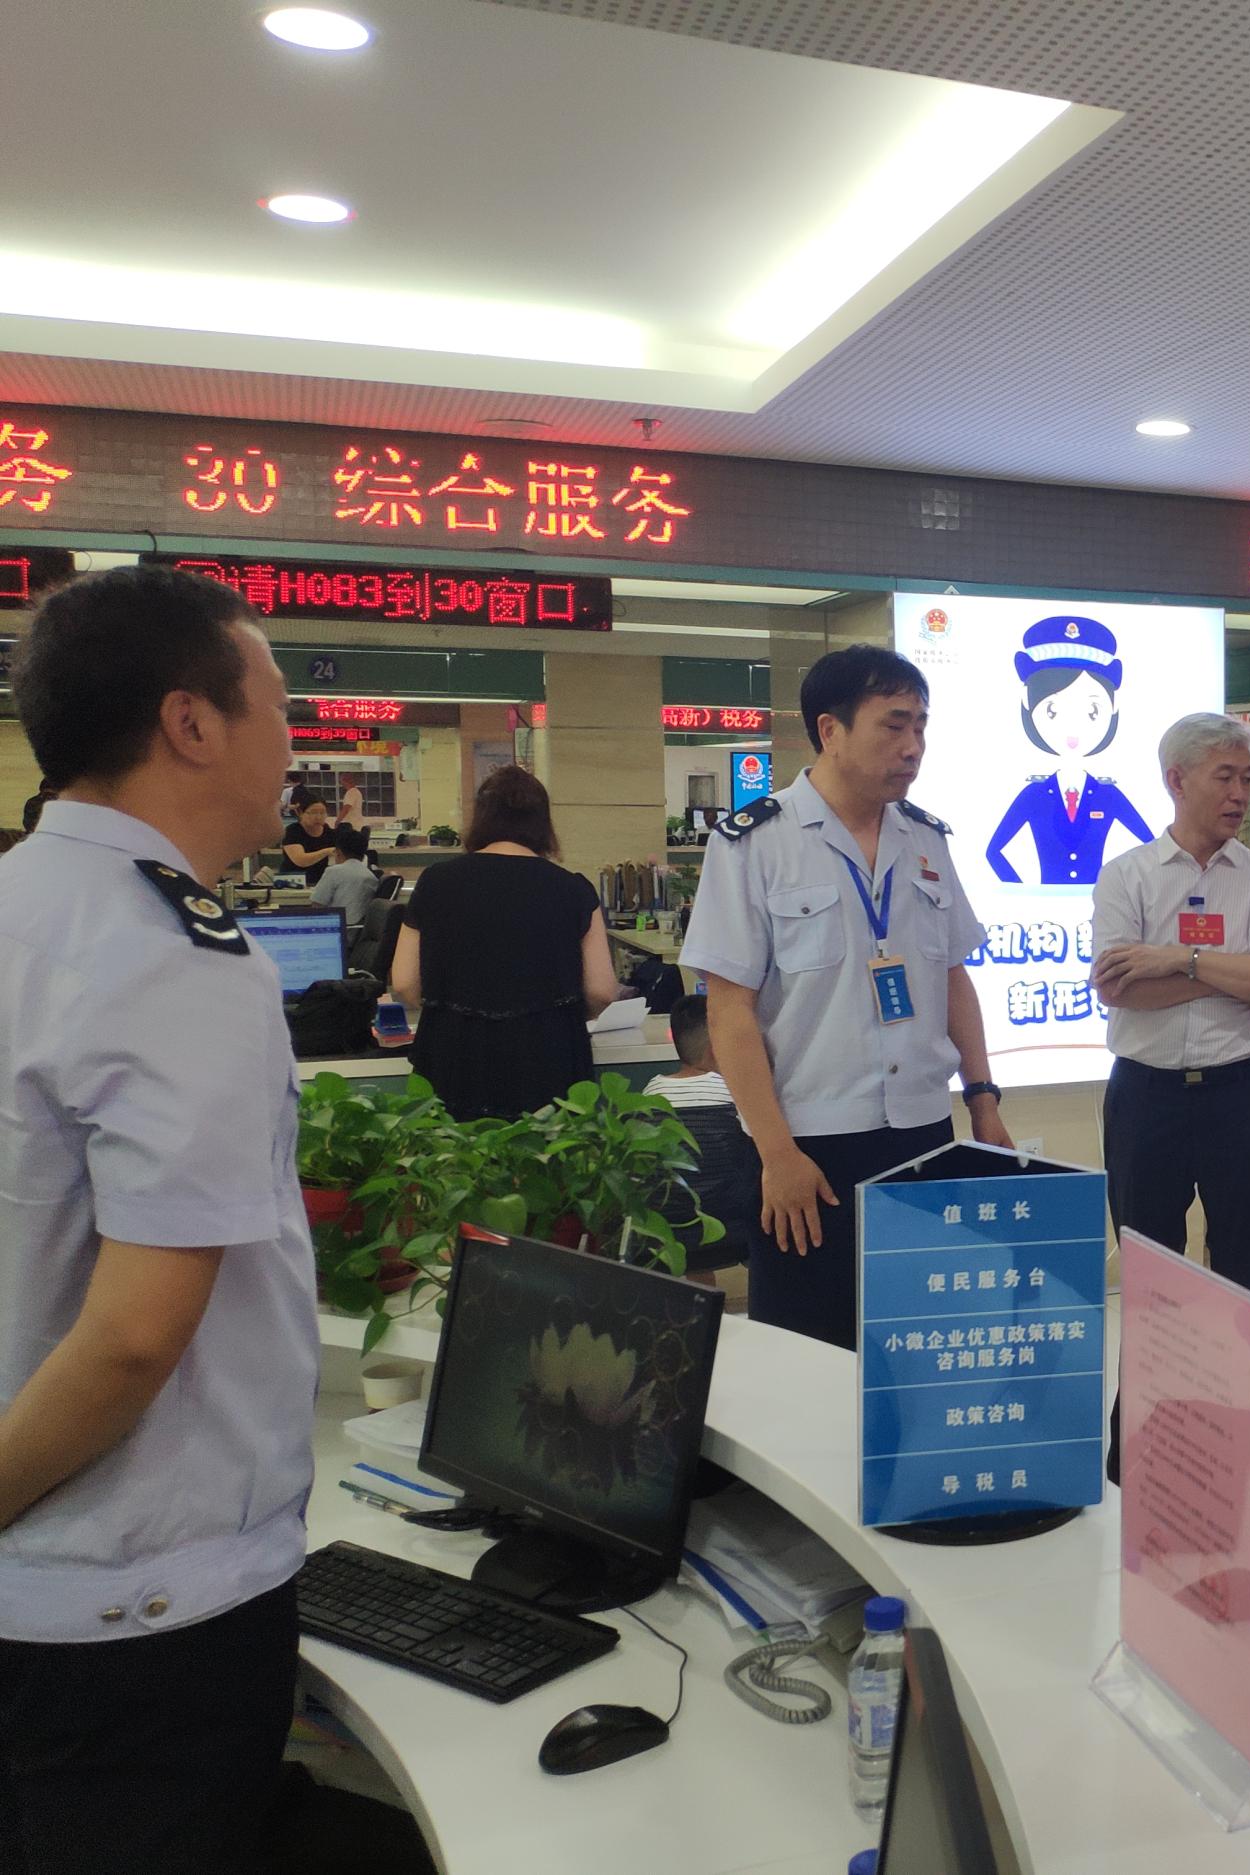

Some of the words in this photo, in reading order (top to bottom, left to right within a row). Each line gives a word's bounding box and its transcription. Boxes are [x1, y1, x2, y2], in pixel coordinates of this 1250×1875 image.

[184, 445, 278, 514] 30
[334, 445, 693, 545] 综合服务
[313, 661, 336, 679] 24
[964, 921, 1069, 967] 机构
[1008, 979, 1109, 1026] 新形
[943, 1200, 1031, 1224] 值班长
[926, 1267, 1046, 1293] 便民服务台
[885, 1320, 1085, 1353] 小微企业优惠政策落实
[937, 1346, 1036, 1371] 咨询服务岗
[945, 1402, 1026, 1427] 政策咨询
[942, 1469, 1029, 1495] 导税员
